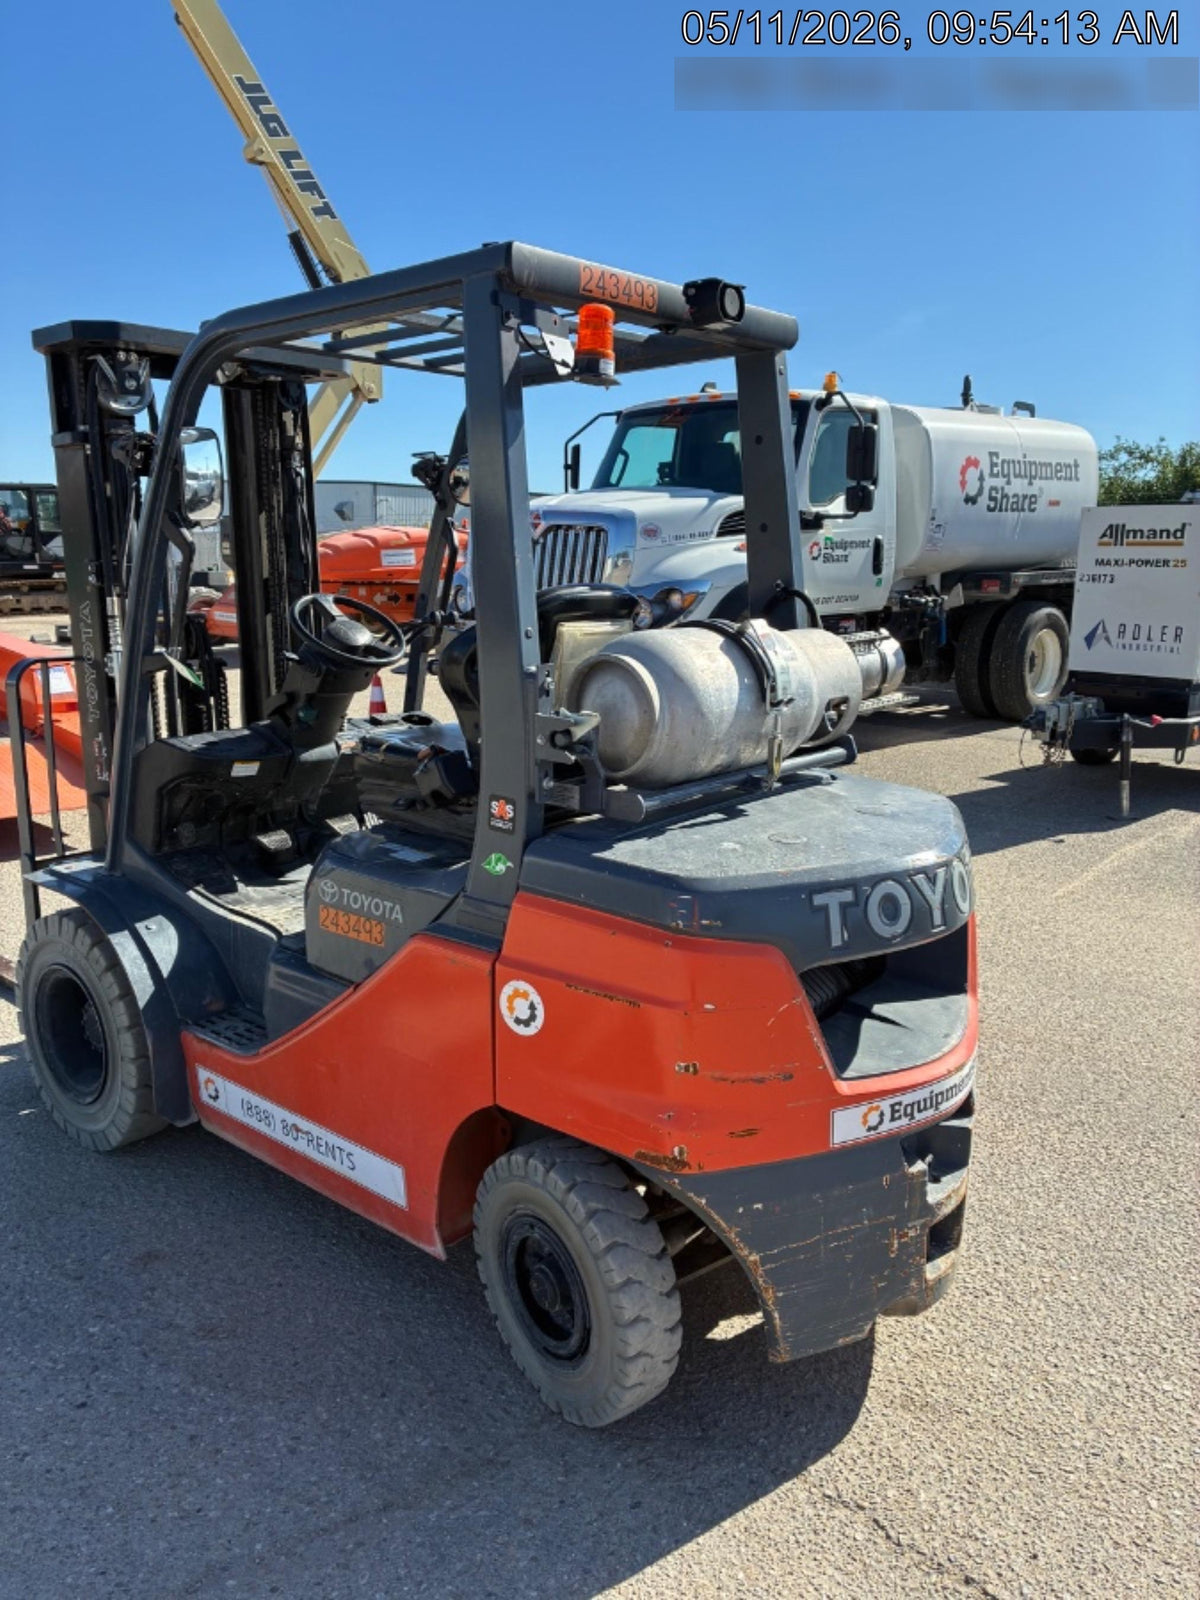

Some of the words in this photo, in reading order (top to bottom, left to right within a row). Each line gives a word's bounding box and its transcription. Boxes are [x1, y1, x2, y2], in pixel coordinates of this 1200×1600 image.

[233, 74, 292, 139] JLG
[277, 149, 340, 222] LIFT
[582, 265, 656, 310] 243493
[988, 451, 1080, 485] Equipment
[986, 485, 1037, 512] Share
[1097, 522, 1187, 546] Allmand
[822, 552, 849, 564] Share
[1095, 558, 1170, 568] MAXI-POWER
[1172, 558, 1187, 568] 25
[1117, 623, 1184, 644] ADLER
[79, 600, 100, 724] TOYOTA
[341, 888, 403, 923] TOYOTA
[321, 905, 384, 945] 243493
[241, 1098, 276, 1131] (888)
